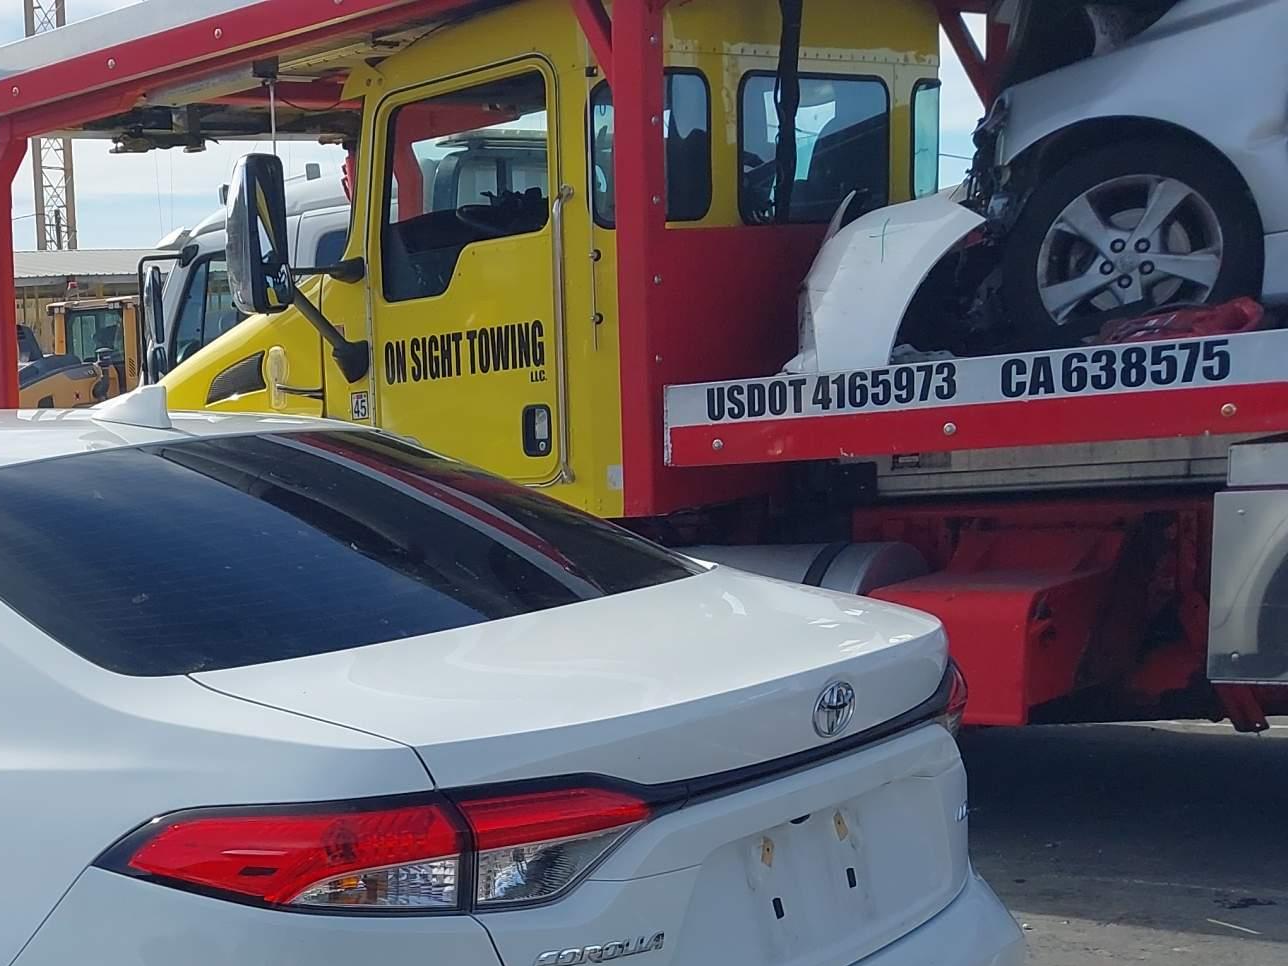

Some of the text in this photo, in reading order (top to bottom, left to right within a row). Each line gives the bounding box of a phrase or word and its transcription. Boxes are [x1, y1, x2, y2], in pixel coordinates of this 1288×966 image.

[384, 319, 545, 385] ON SIGHT TOWING
[1000, 338, 1231, 398] CA 638575
[353, 399, 367, 417] 45
[705, 362, 957, 422] USDOT 4165973
